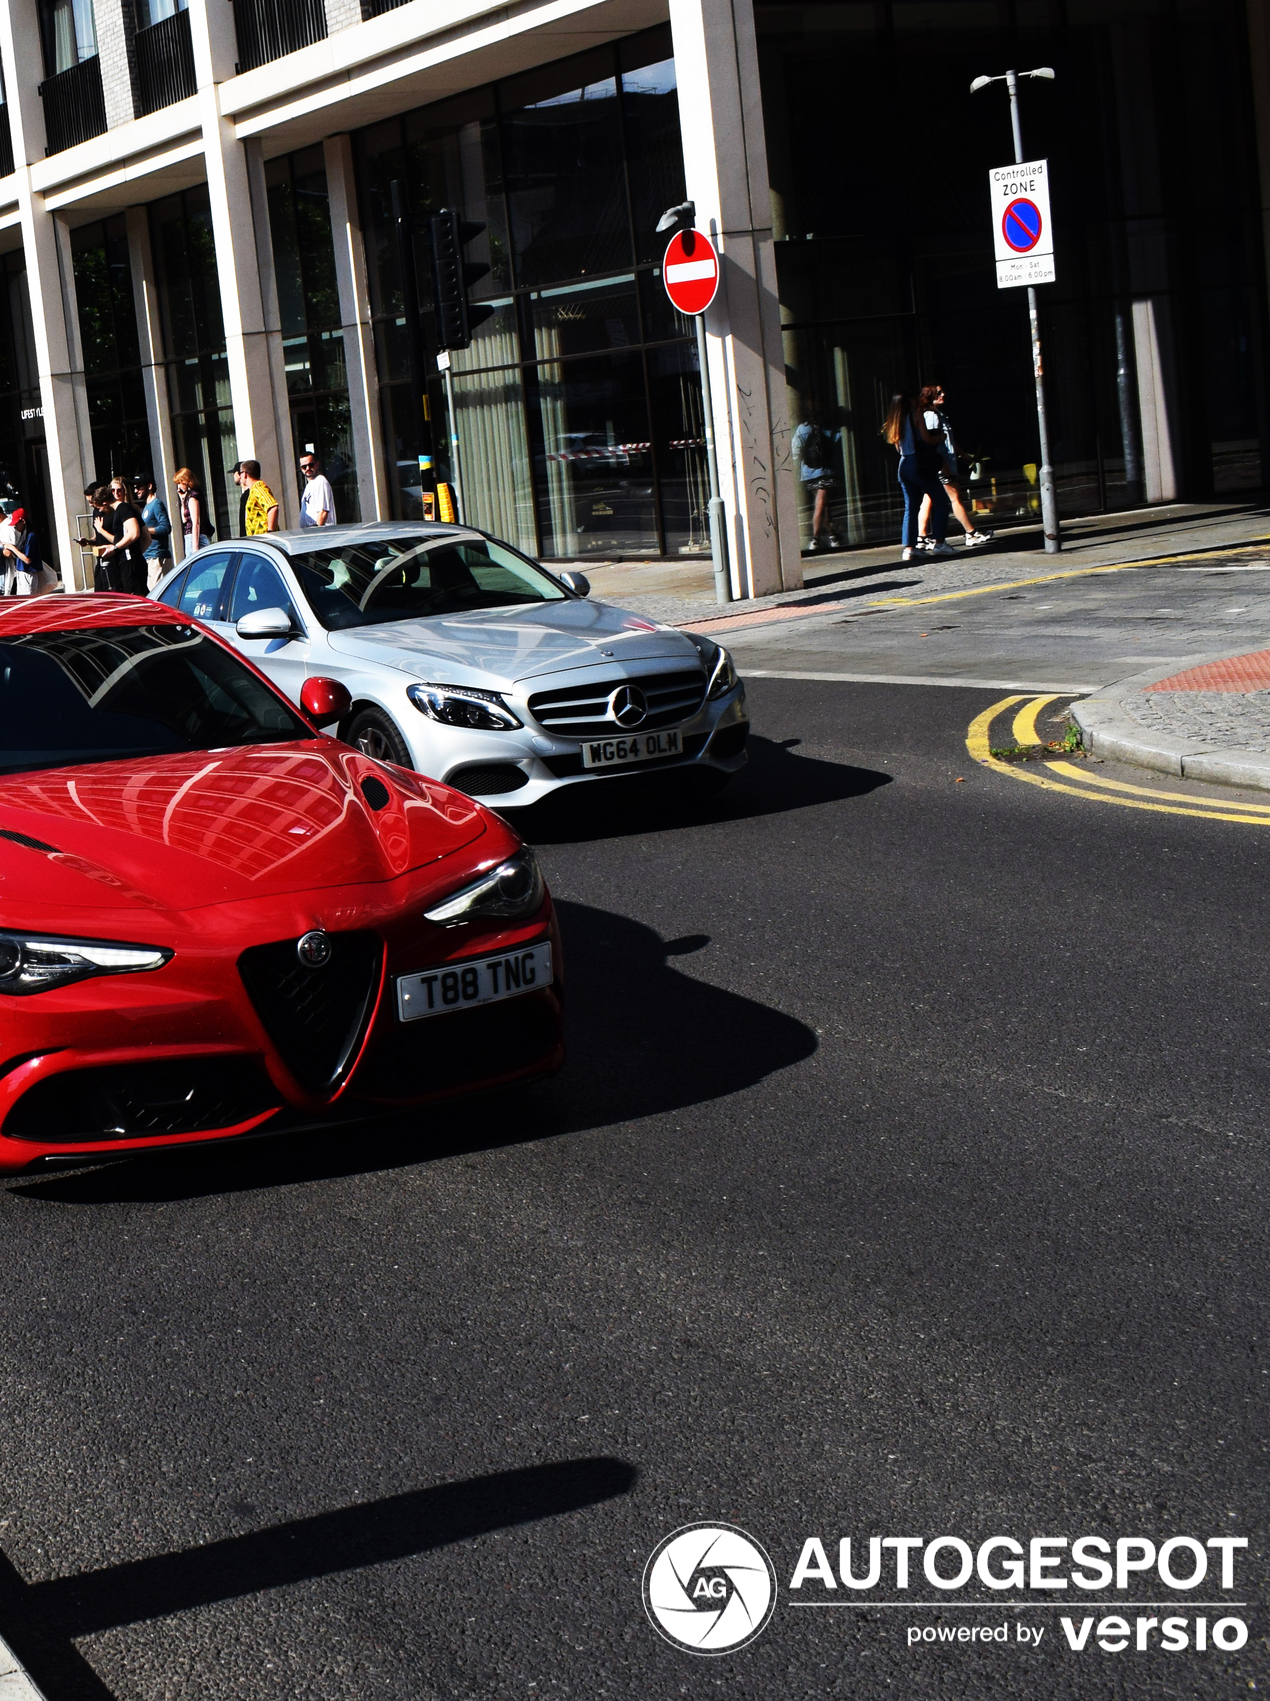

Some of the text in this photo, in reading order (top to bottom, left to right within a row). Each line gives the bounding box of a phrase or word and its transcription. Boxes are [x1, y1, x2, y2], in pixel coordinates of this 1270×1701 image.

[994, 164, 1043, 182] Controlled
[1003, 180, 1036, 196] ZONE
[1029, 261, 1040, 269] Sat
[590, 732, 678, 763] WG64 OLM
[420, 952, 536, 1009] T88 TNG
